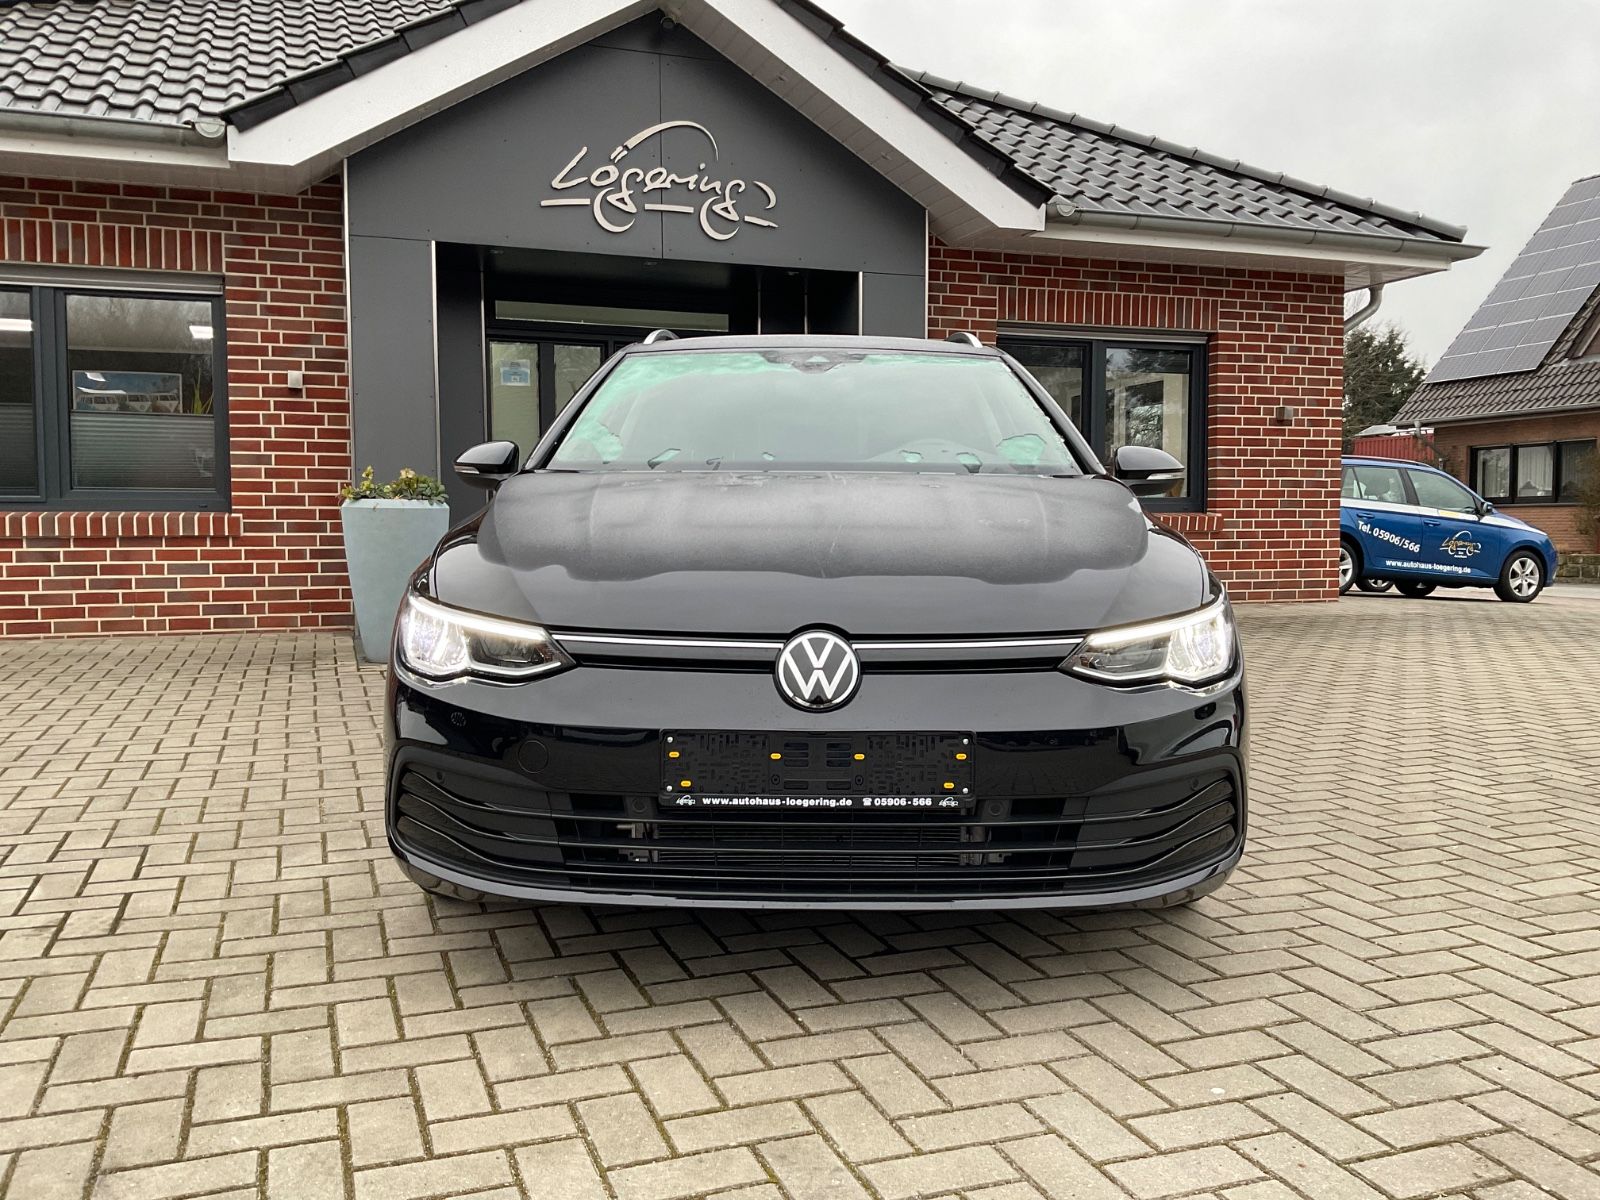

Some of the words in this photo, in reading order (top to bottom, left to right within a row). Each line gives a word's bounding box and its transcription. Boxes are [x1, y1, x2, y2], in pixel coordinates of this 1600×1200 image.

[1357, 520, 1372, 534] Tel.
[1372, 527, 1421, 553] 05906/566
[1385, 559, 1472, 574] www.autohaus-loegering.de
[702, 797, 853, 807] www.autohaus-loegering.de
